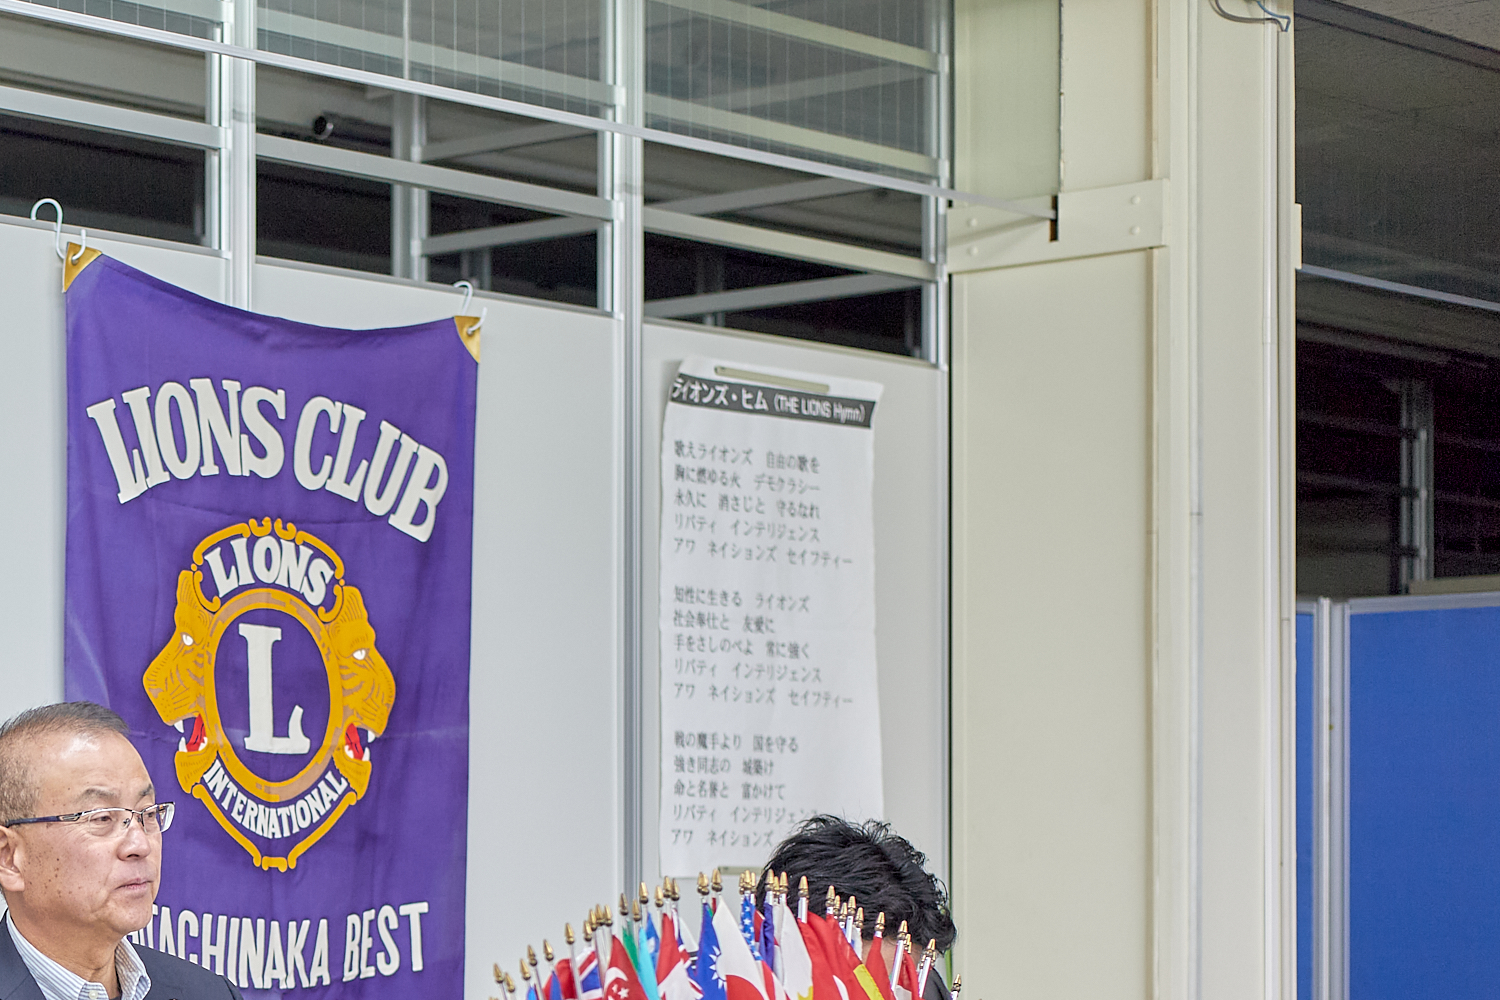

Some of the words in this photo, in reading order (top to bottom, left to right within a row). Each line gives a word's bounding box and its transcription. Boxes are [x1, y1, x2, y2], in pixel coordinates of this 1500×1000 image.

[801, 398, 831, 418] LIONS
[86, 377, 286, 504] LIONS
[293, 395, 449, 543] CLUB
[203, 535, 335, 606] LIONS
[238, 622, 311, 755] L
[202, 758, 349, 839] INTERNATIONAL
[130, 904, 331, 990] ACHINAKA
[342, 901, 430, 982] BEST
